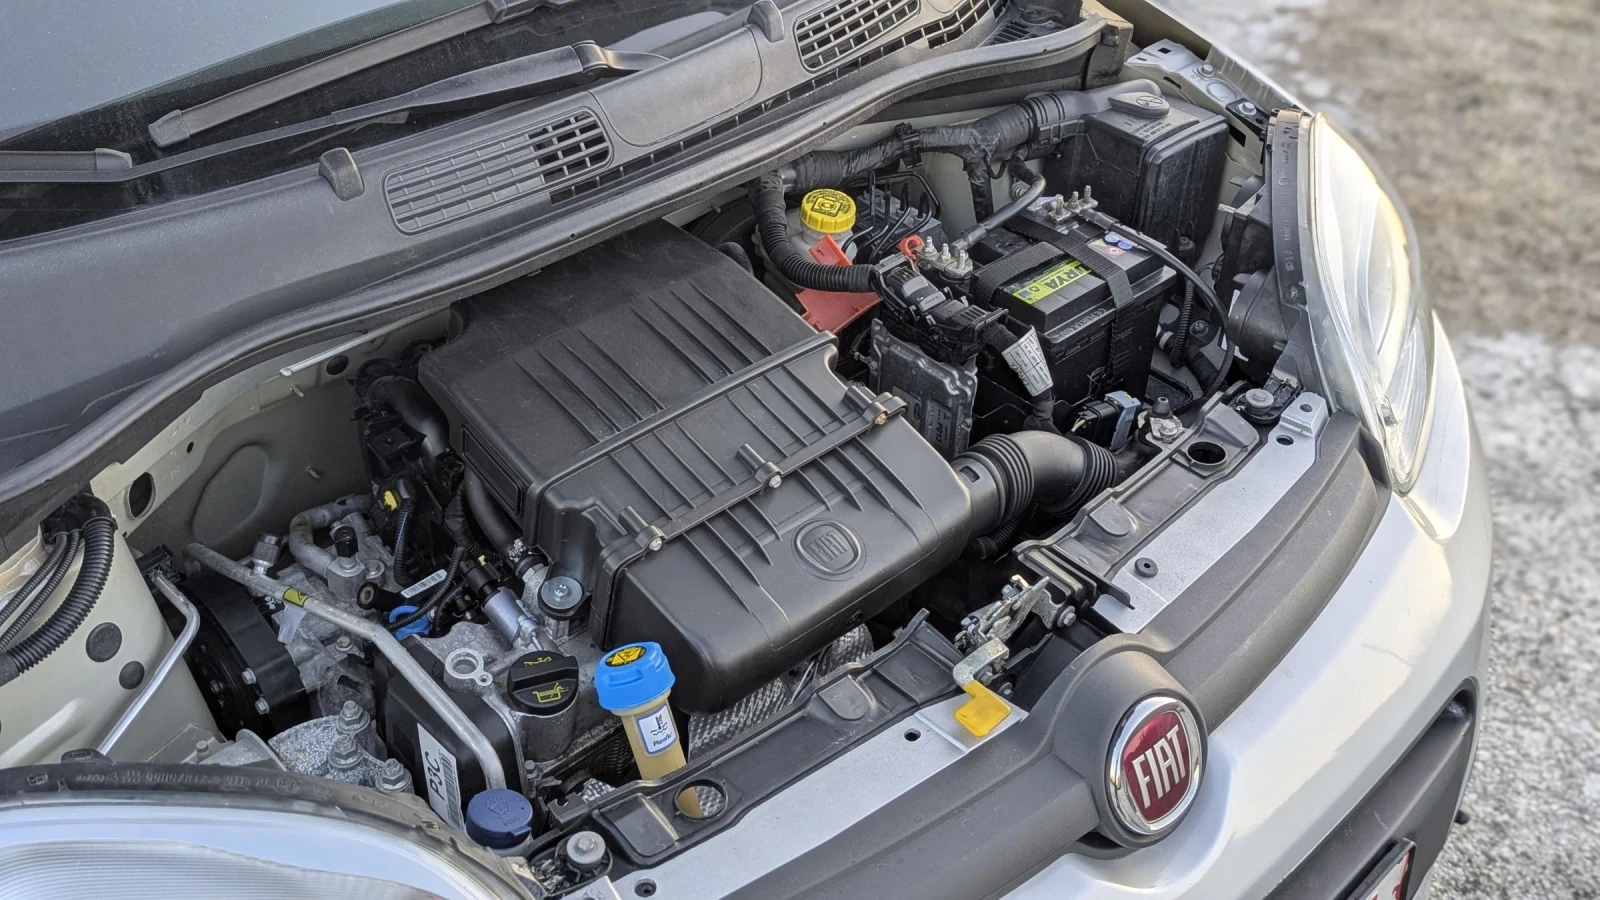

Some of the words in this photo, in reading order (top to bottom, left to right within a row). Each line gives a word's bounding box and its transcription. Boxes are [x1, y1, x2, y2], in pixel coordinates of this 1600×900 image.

[1043, 265, 1086, 290] URYA
[807, 530, 849, 564] FIAT
[424, 750, 445, 801] P3C
[1131, 724, 1186, 809] FIAT
